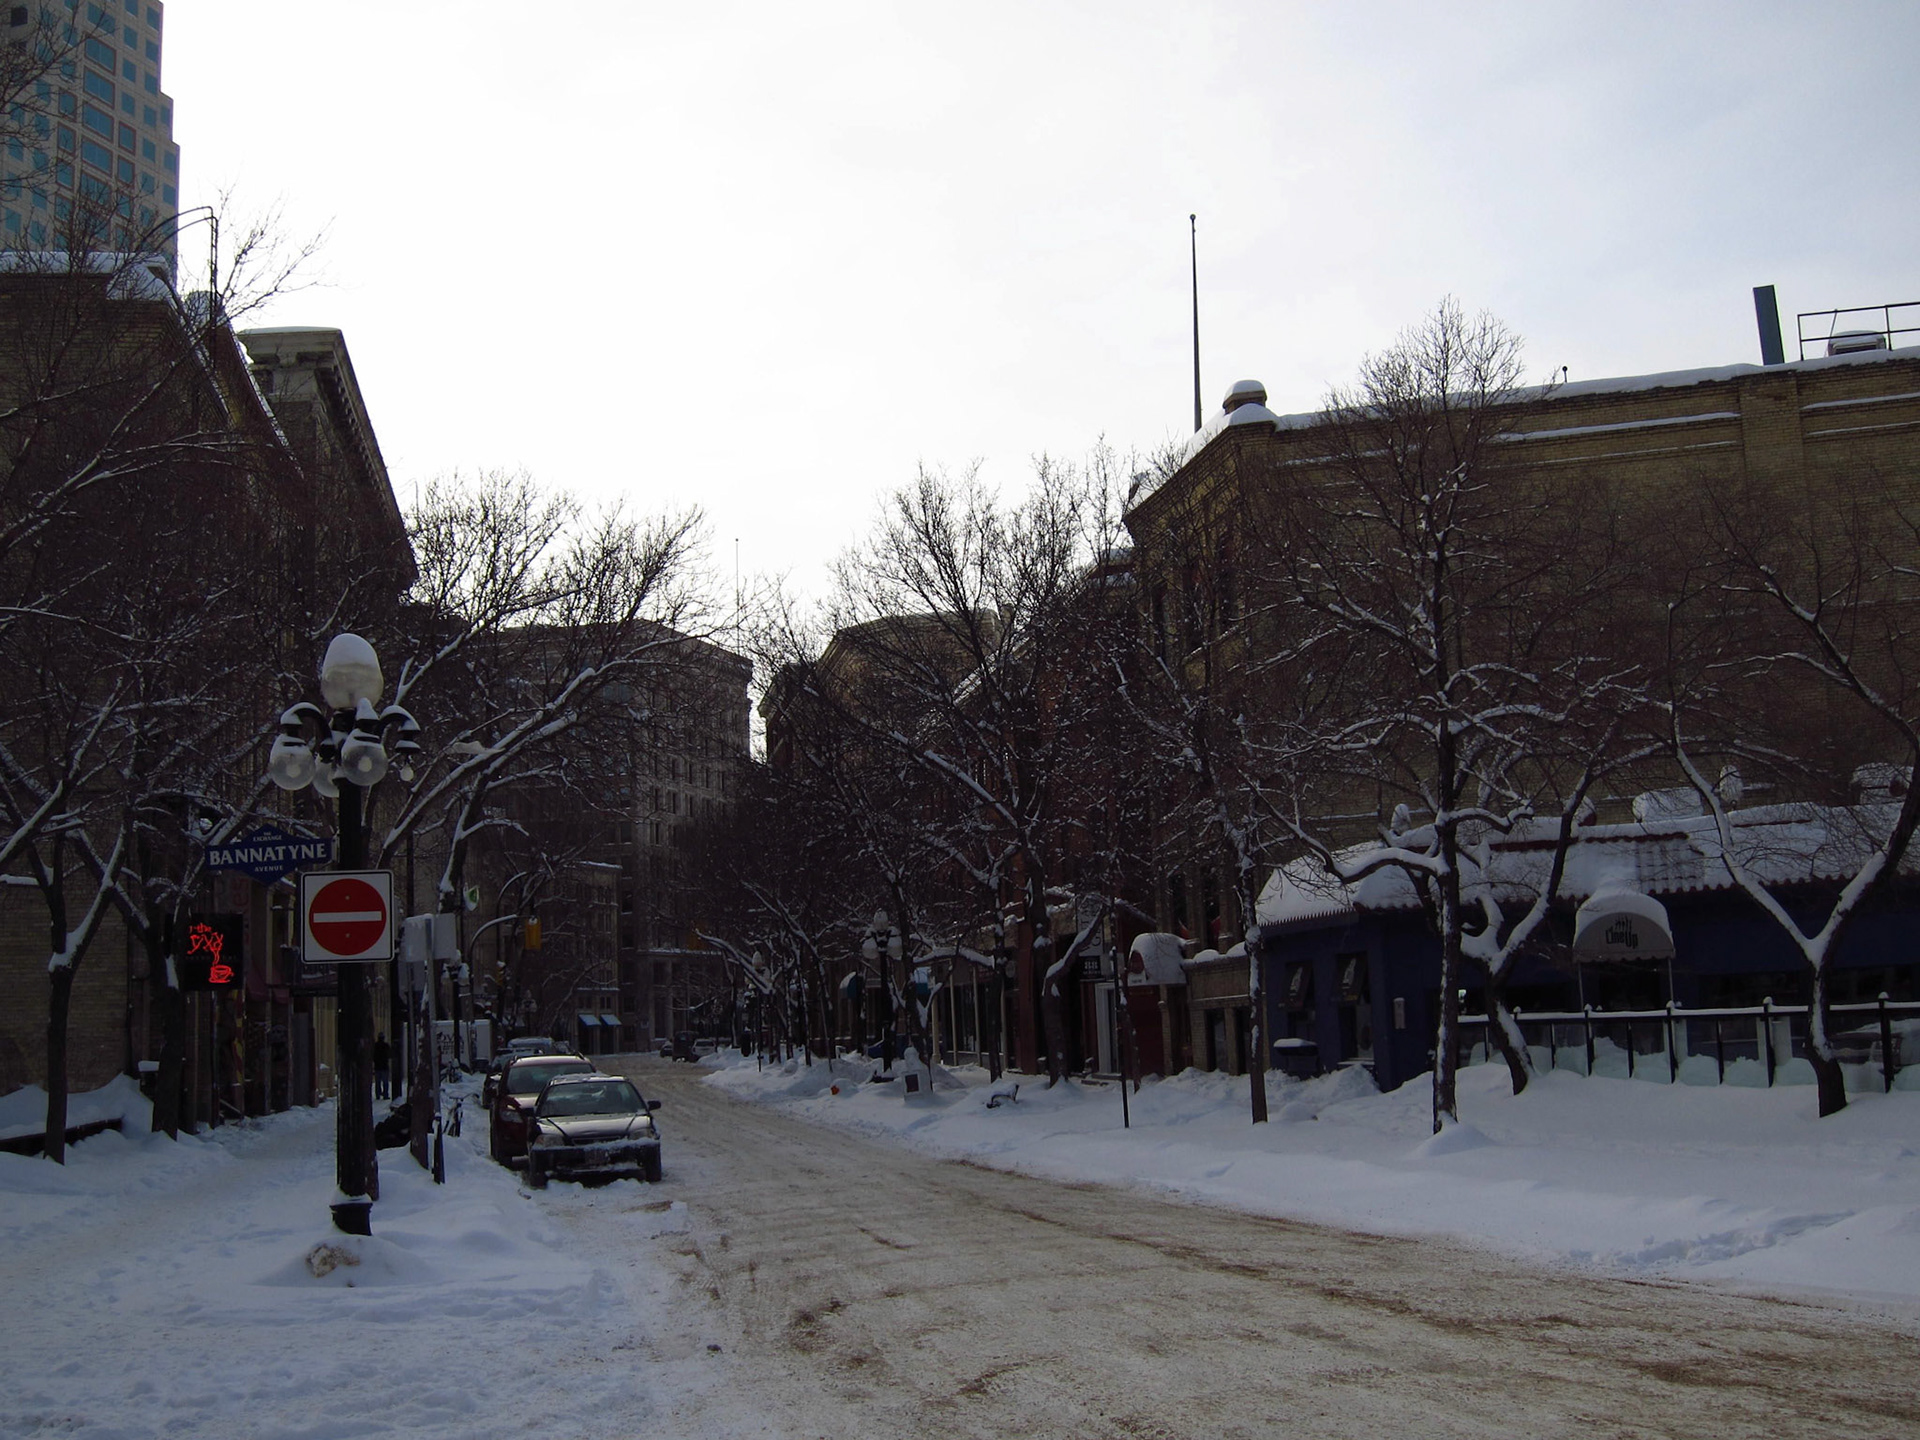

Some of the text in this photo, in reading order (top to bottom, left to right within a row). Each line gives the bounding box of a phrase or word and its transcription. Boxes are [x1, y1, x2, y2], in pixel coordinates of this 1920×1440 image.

[253, 834, 282, 842] EXCHANGE
[209, 843, 327, 866] BANNATYNE
[254, 865, 284, 873] AVENUE
